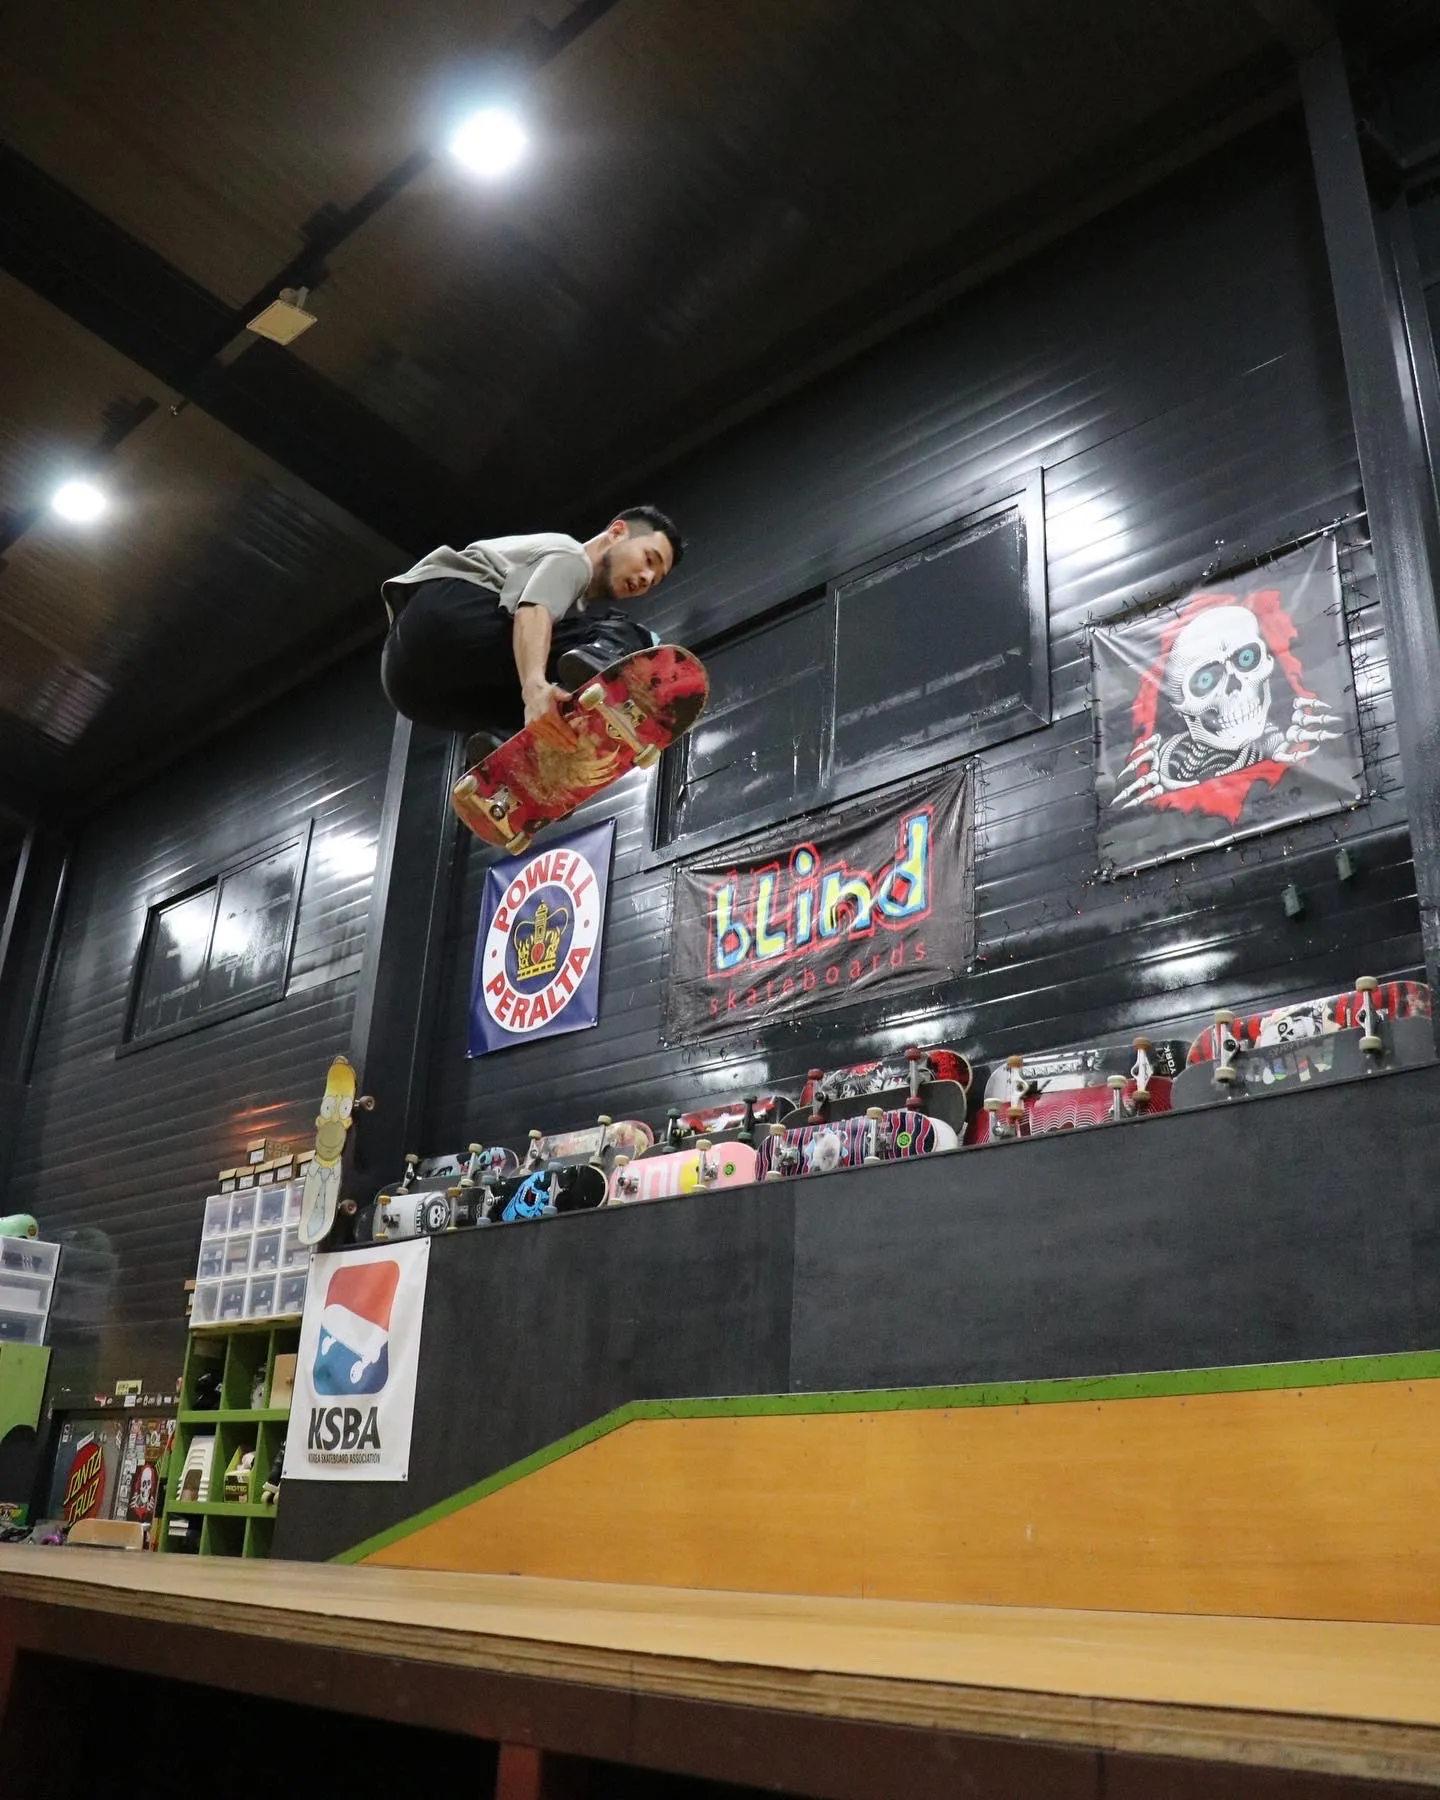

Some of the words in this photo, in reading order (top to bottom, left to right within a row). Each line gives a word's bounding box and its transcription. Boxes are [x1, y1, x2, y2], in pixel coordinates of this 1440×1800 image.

[494, 852, 593, 933] POWELL
[486, 947, 591, 1028] PERALTA
[709, 941, 927, 1015] skateboards
[1164, 1044, 1176, 1075] YORK
[308, 1406, 381, 1450] KSBA
[63, 1446, 102, 1505] SANTA
[350, 1453, 380, 1464] ASSOCIATION
[68, 1478, 100, 1527] CRUZ
